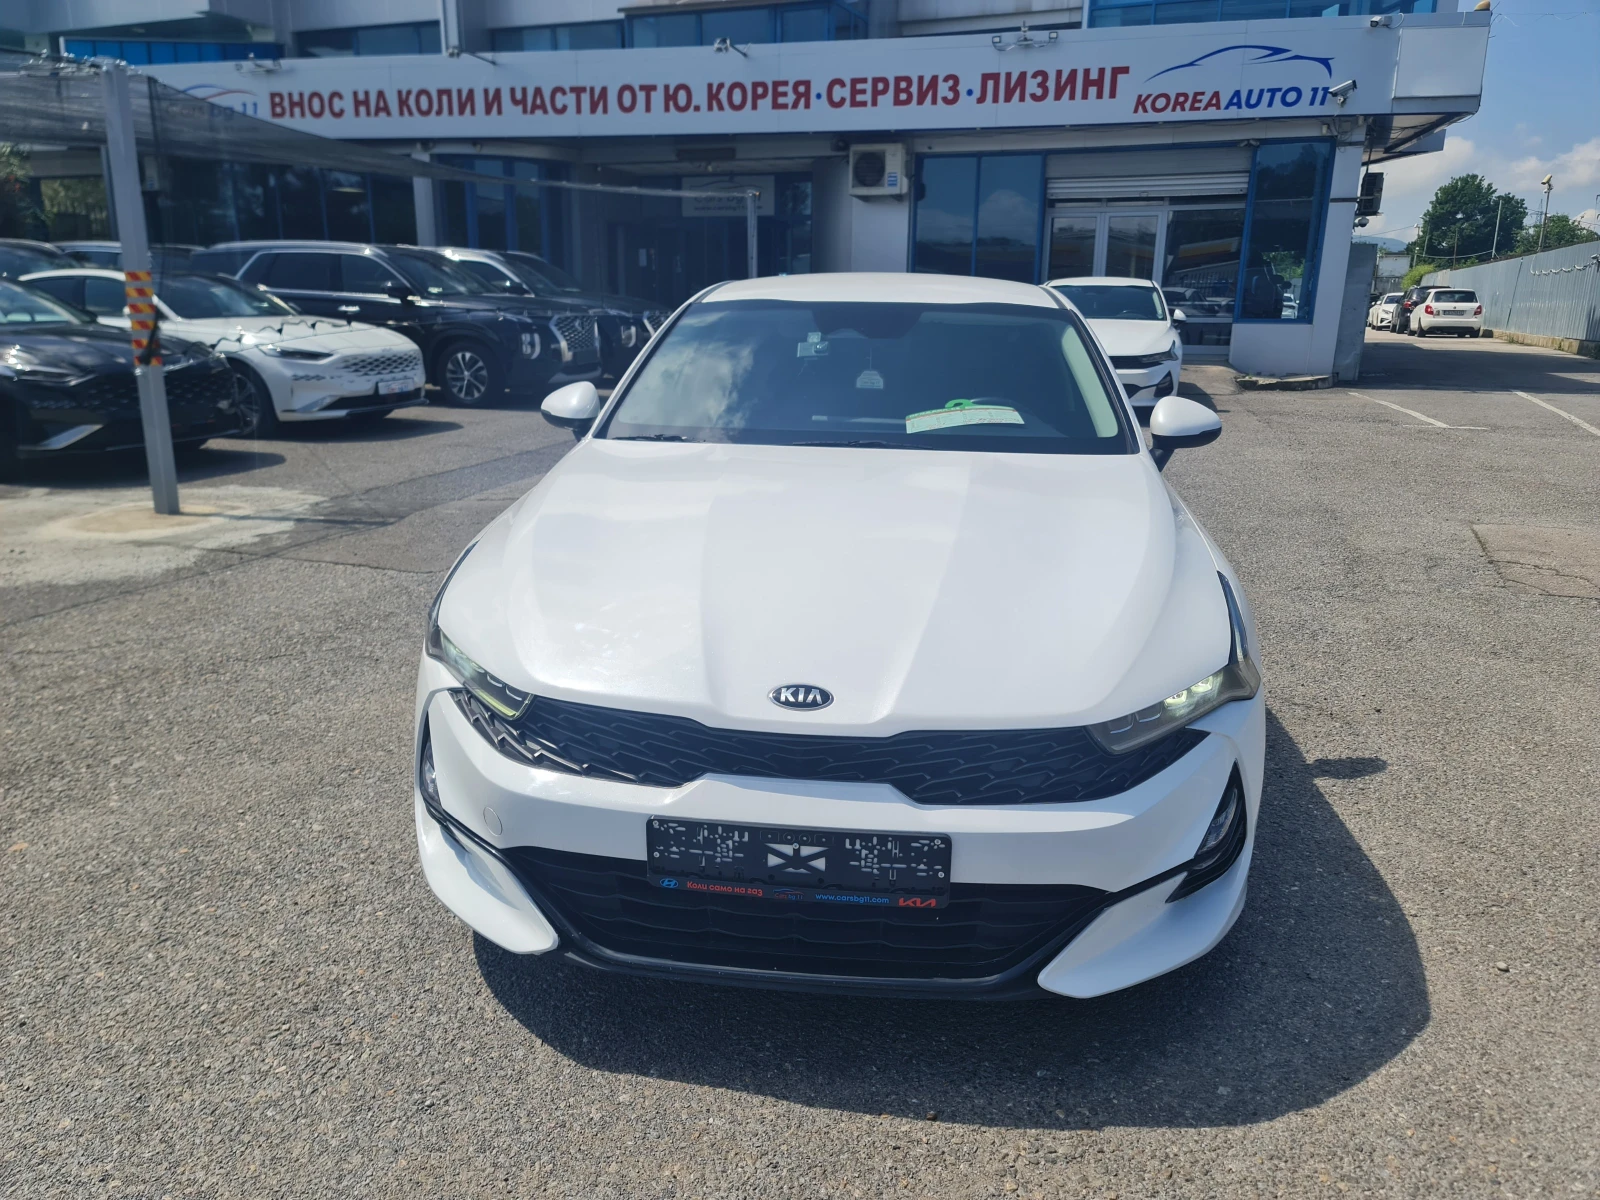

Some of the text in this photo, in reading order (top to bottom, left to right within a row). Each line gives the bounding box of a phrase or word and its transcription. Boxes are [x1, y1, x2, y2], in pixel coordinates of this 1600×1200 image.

[269, 65, 1131, 119] ВНОС НА КОЛИ И ЧАСТИ ОТ Ю. КОРЕЯ СЕРВИЗ ЛИЗИНГ
[1132, 86, 1331, 115] KOREA AUTO 11
[780, 687, 823, 705] KIA
[686, 880, 763, 897] Коли само на газ
[815, 893, 890, 904] www.carsbg11.com
